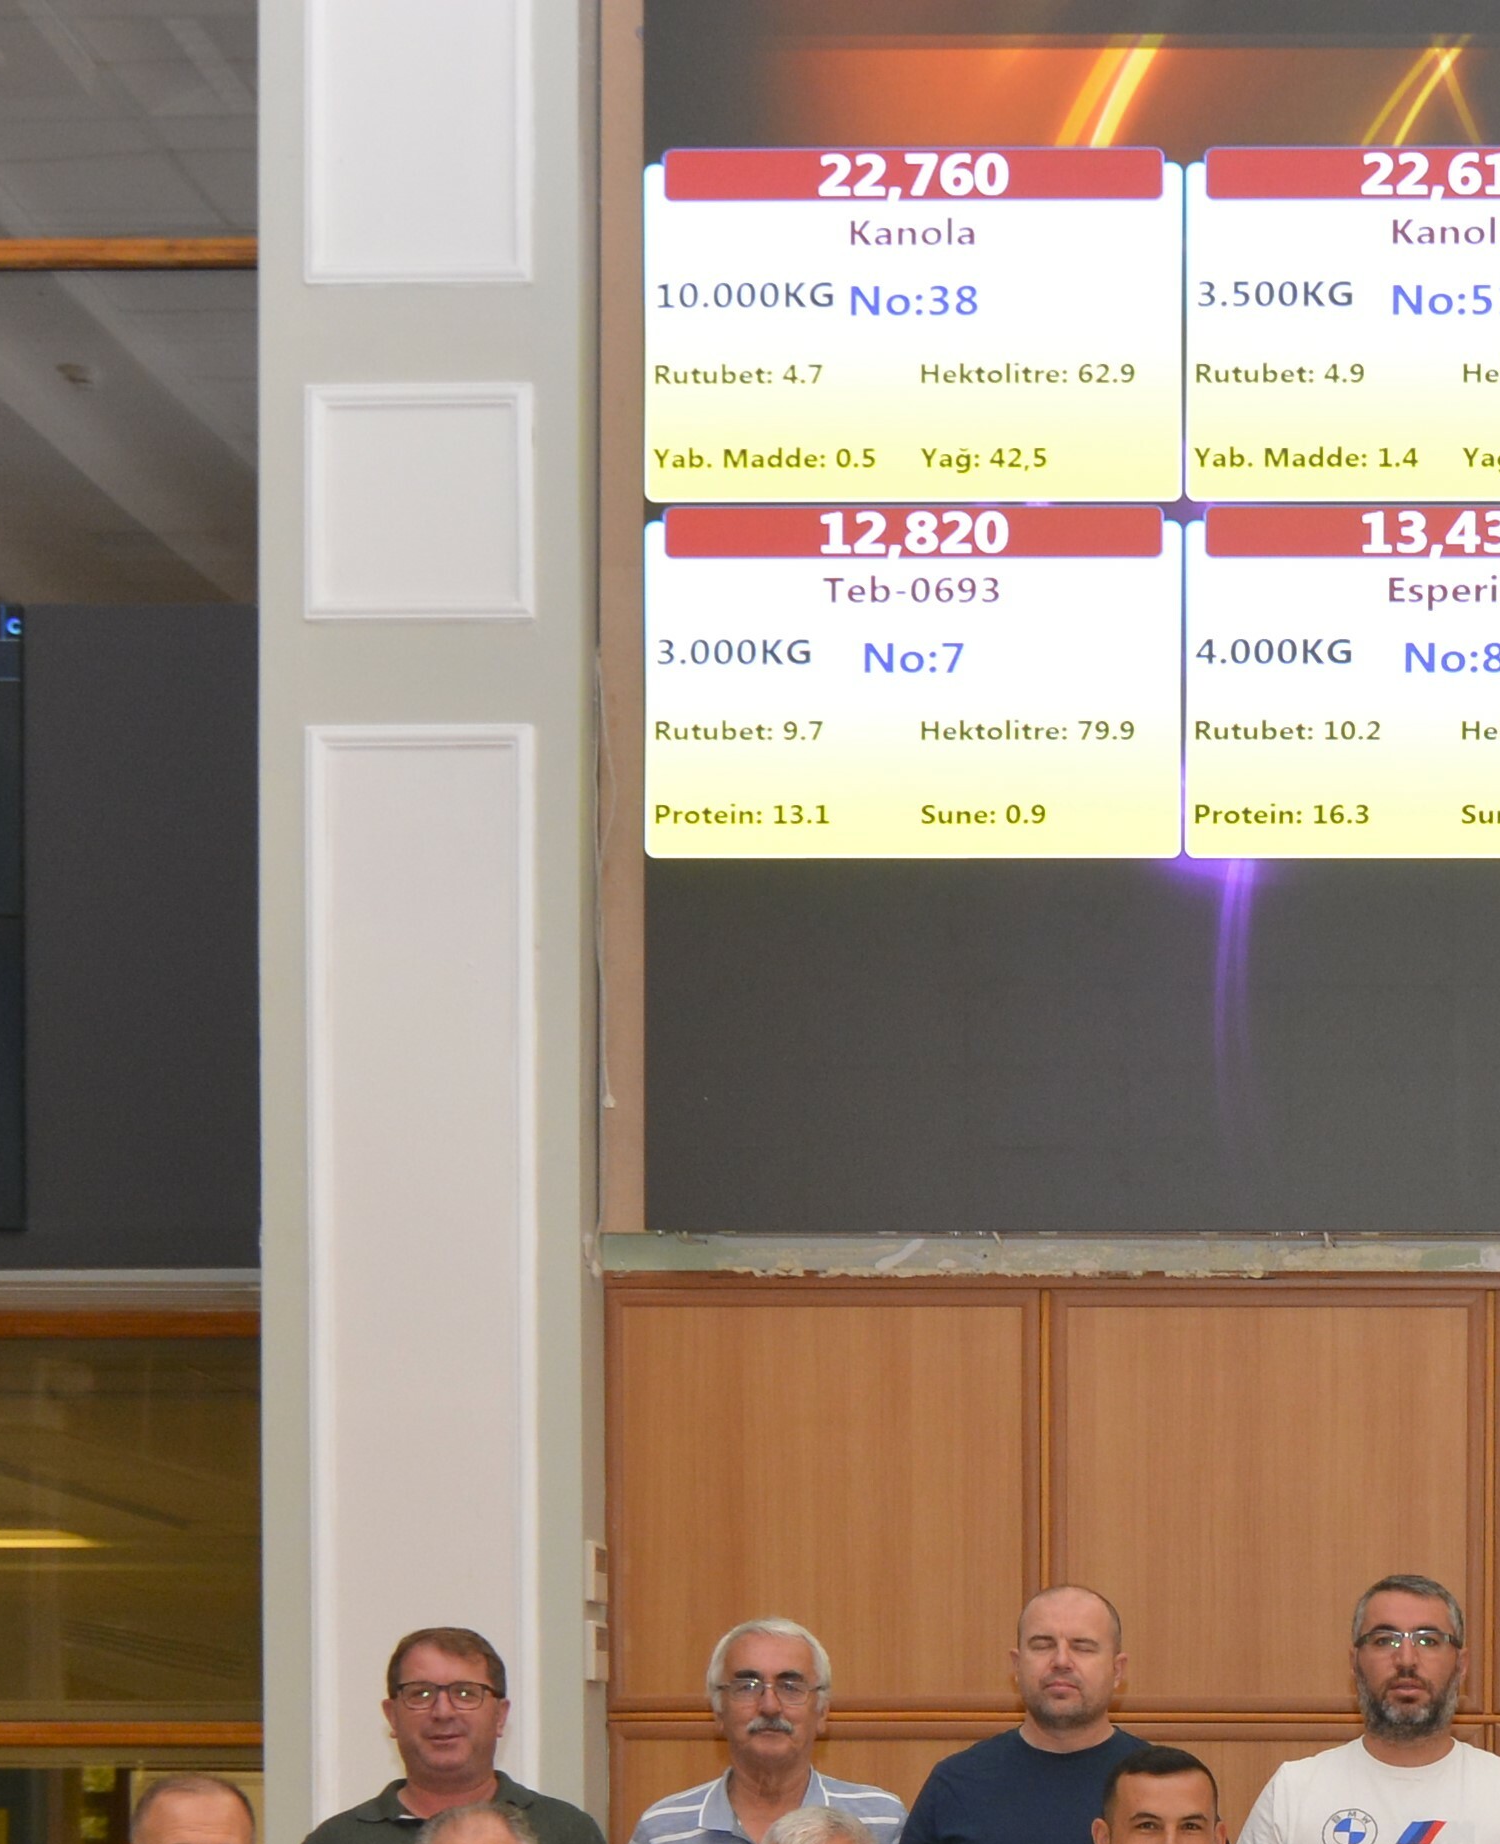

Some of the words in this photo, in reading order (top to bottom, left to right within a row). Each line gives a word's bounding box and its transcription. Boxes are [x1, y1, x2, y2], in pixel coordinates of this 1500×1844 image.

[817, 152, 1010, 200] 22,760
[850, 217, 975, 246] Kanola
[657, 281, 834, 309] 10.000KG
[850, 285, 978, 317] No:38
[1197, 280, 1353, 307] 3.500KG
[654, 363, 773, 385] Rutubet:
[782, 364, 823, 384] 4.7
[920, 362, 1068, 384] Hektolitre:
[1078, 363, 1136, 384] 62.9
[1195, 362, 1314, 384] Rutubet:
[1323, 363, 1365, 384] 4.9
[653, 447, 712, 469] Yab.
[723, 446, 826, 469] Madde:
[835, 447, 876, 469] 0.5
[920, 447, 980, 474] Yağ:
[989, 447, 1047, 472] 42,5
[1194, 445, 1253, 468] Yab.
[1264, 445, 1367, 468] Madde:
[1378, 447, 1419, 468] 1.4
[819, 510, 1010, 558] 12,820
[822, 574, 1000, 604] Teb-0693
[657, 638, 812, 666] 3.000KG
[864, 642, 965, 674] No:7
[1195, 638, 1352, 665] 4.000KG
[655, 719, 773, 741] Rutubet:
[783, 720, 824, 741] 9.7
[920, 719, 1068, 741] Hektolitre:
[1077, 720, 1135, 741] 79.9
